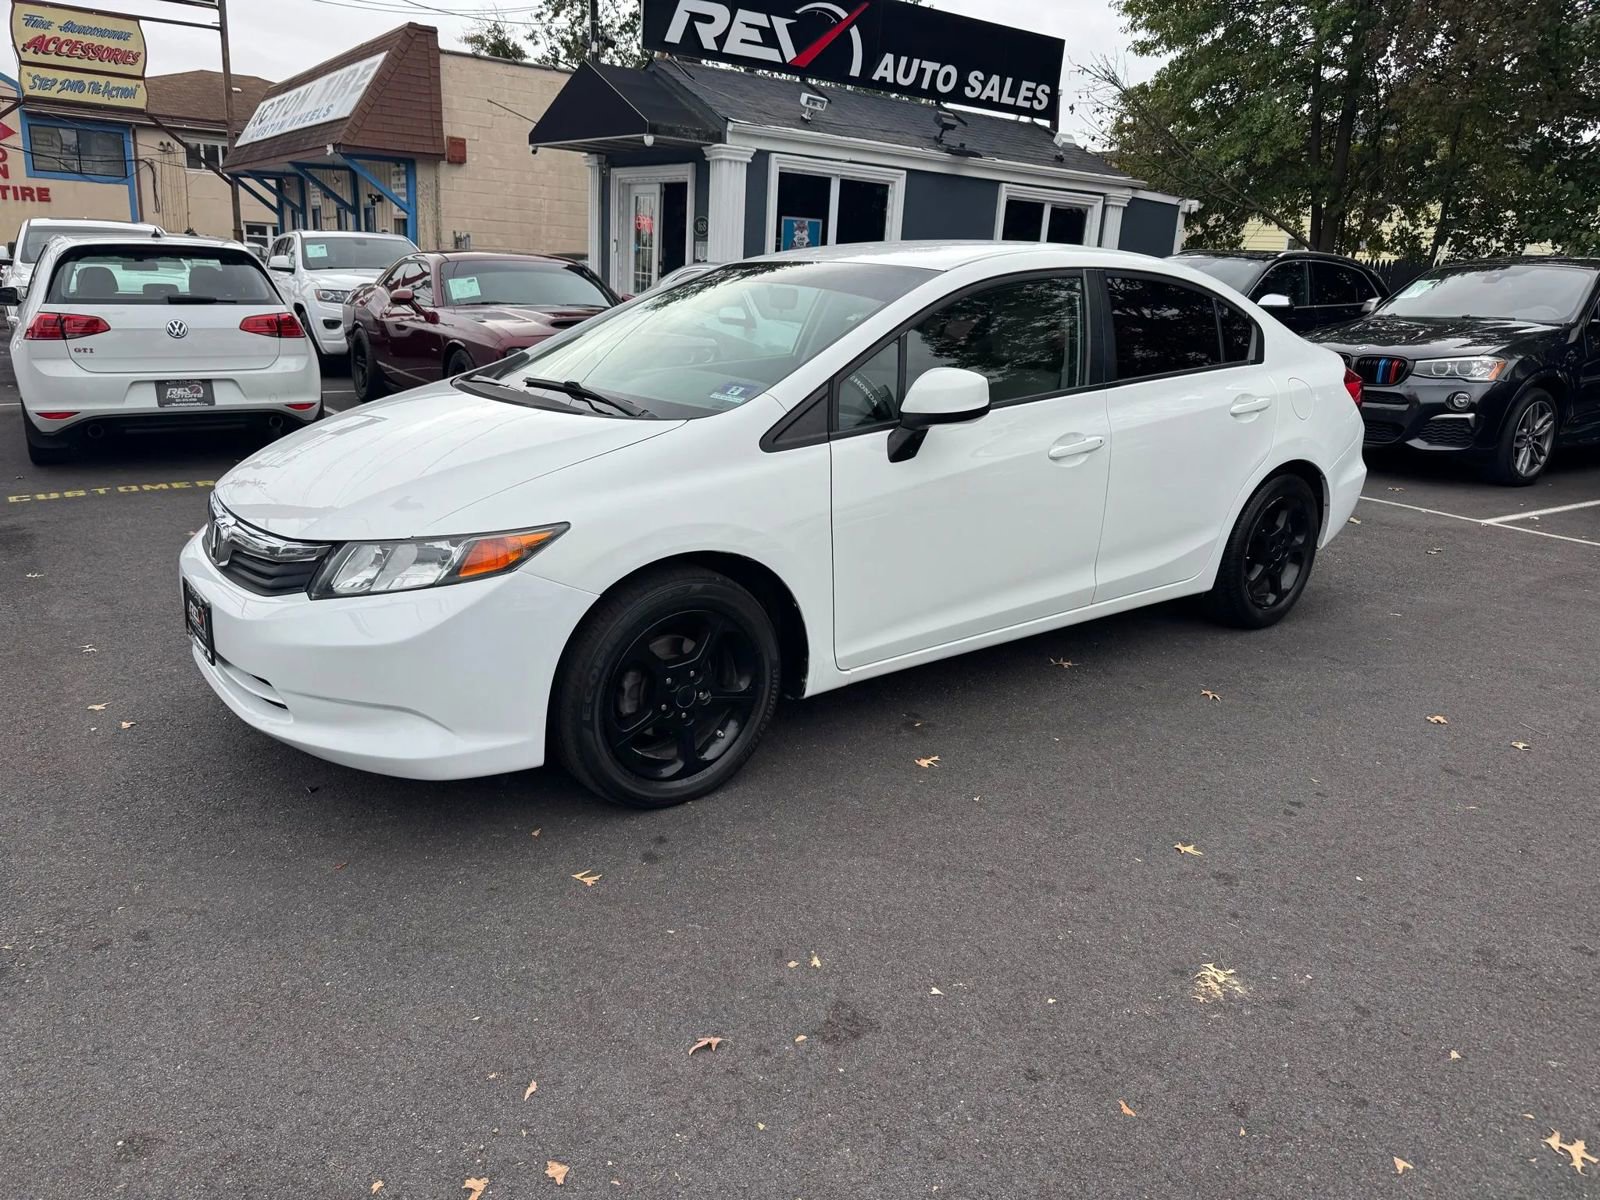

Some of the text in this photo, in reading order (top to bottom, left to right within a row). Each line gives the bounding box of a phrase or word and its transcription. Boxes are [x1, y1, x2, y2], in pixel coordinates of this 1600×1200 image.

[22, 33, 141, 65] ACCESSORIES
[249, 61, 379, 128] ACTION TIRE
[872, 52, 1051, 111] AUTO SALES
[287, 103, 334, 128] WHEELS
[0, 184, 51, 203] TIRE
[8, 480, 215, 503] CUSTOMER
